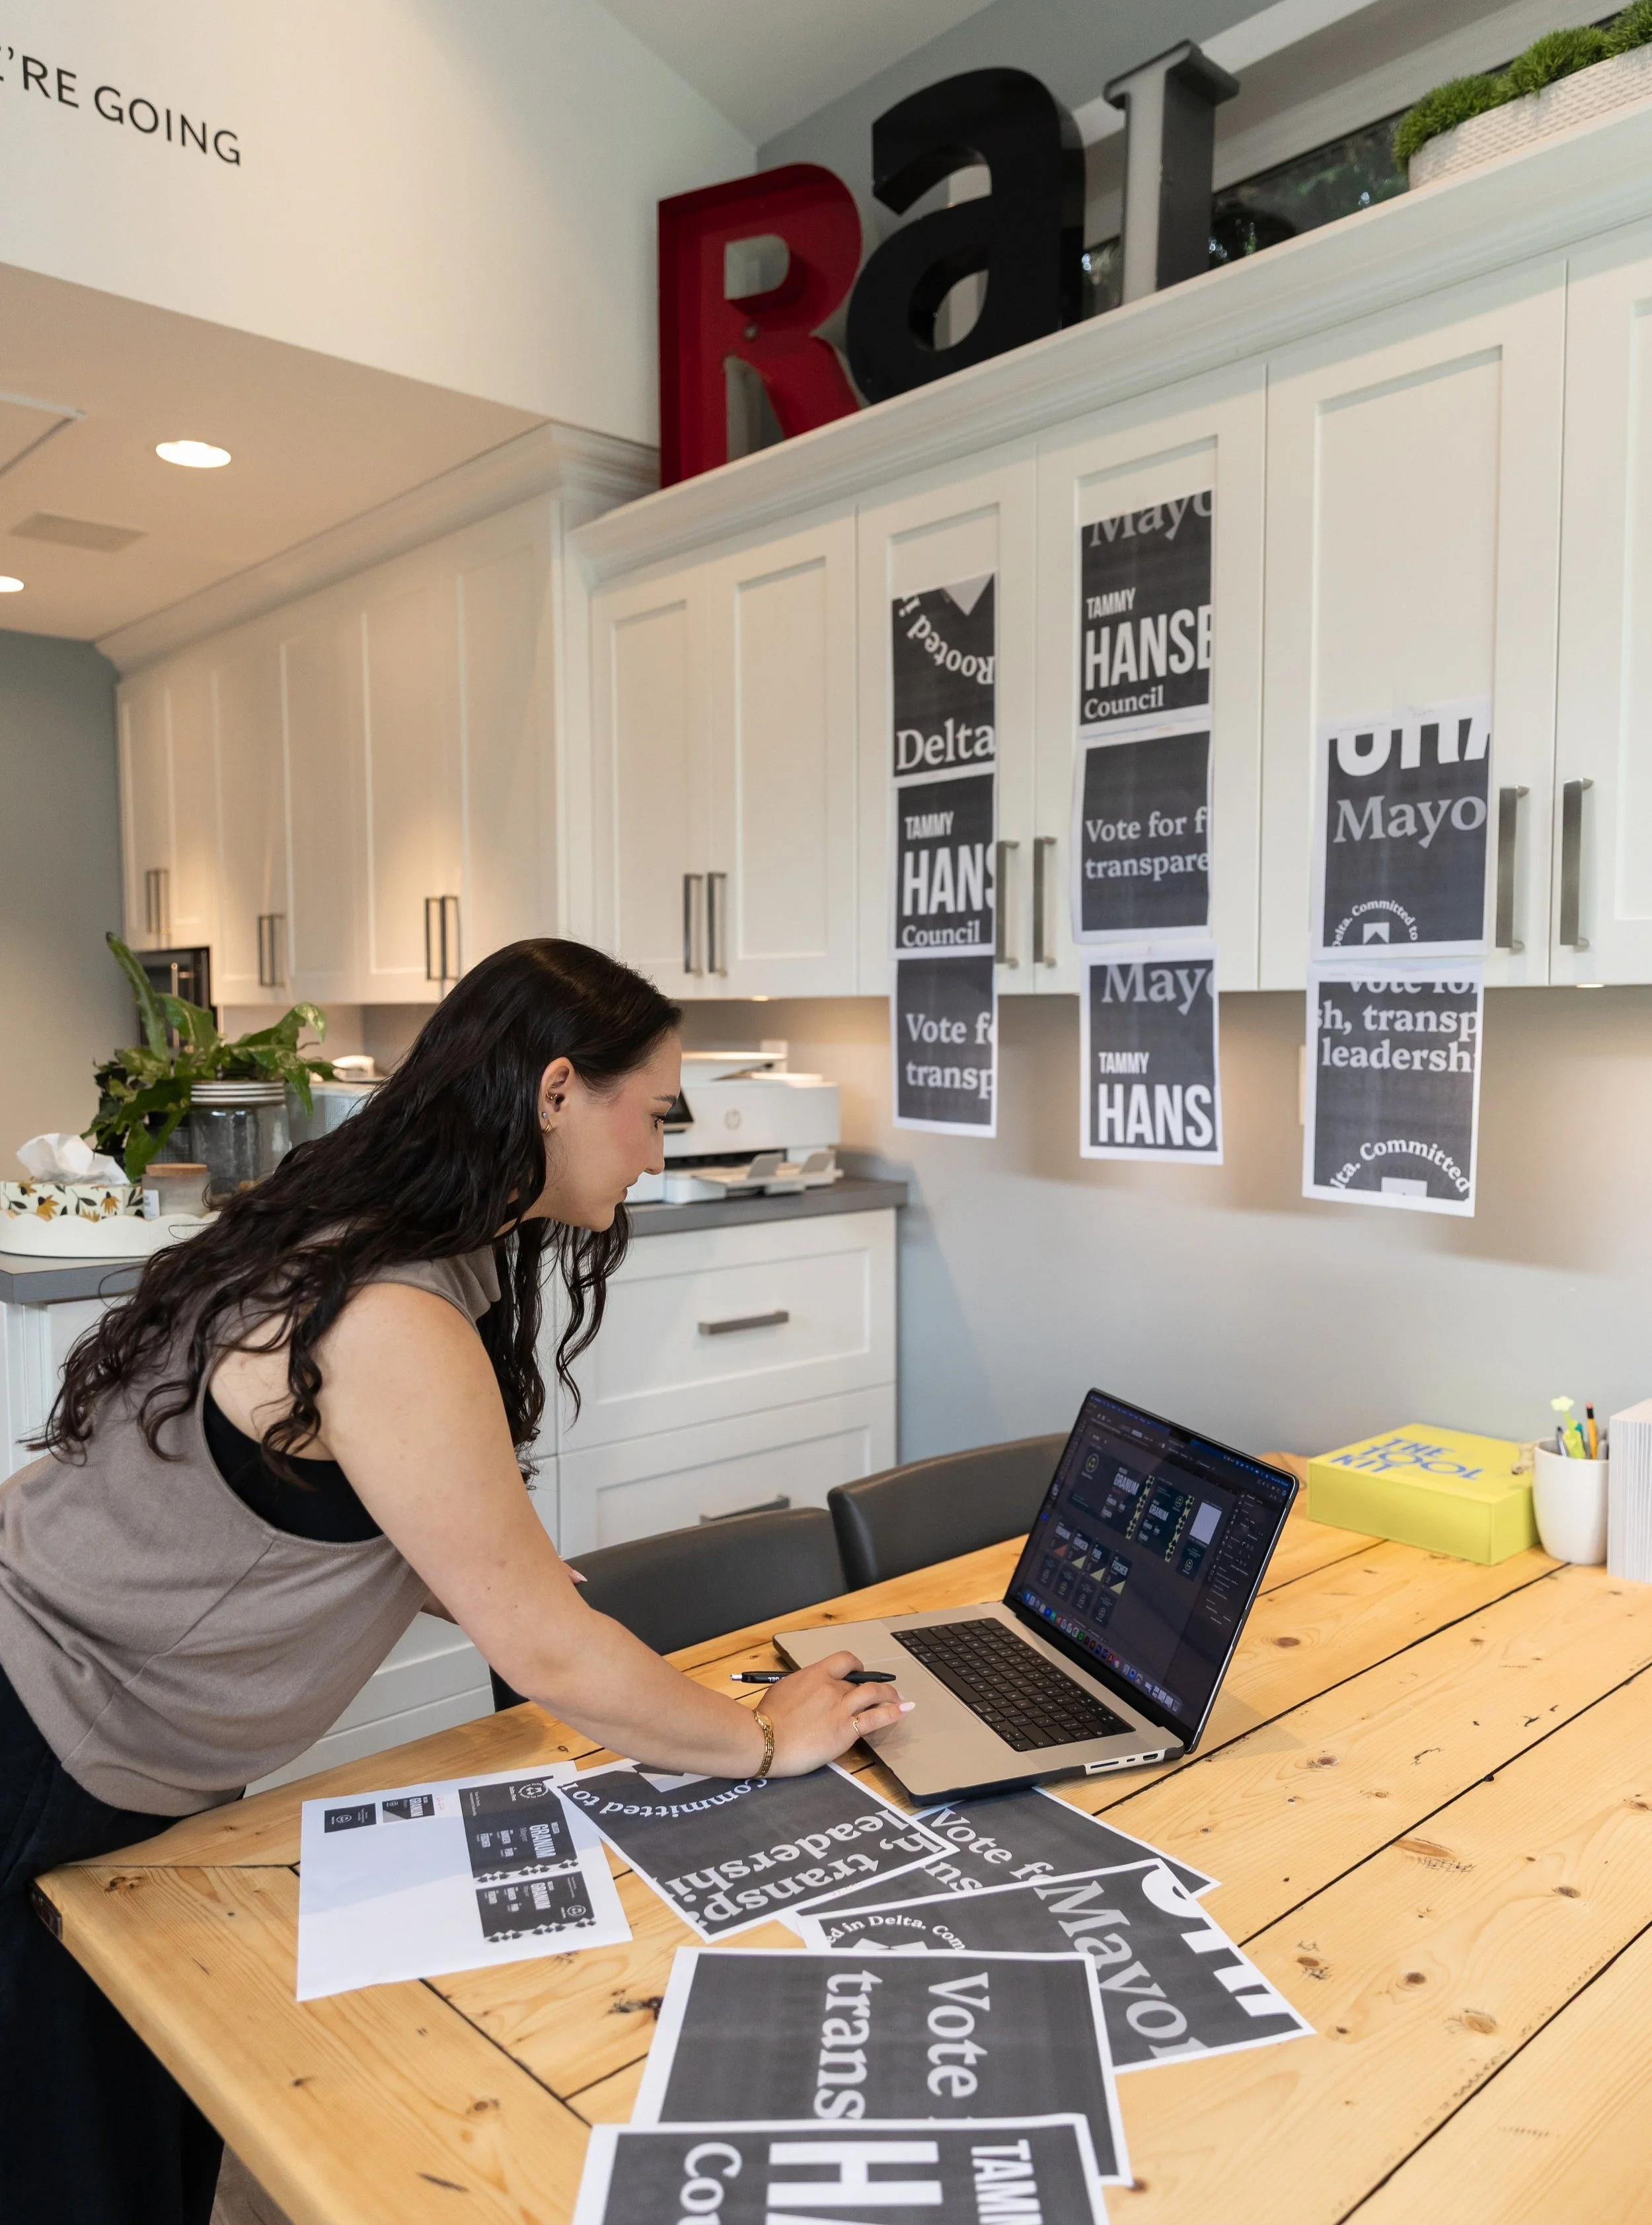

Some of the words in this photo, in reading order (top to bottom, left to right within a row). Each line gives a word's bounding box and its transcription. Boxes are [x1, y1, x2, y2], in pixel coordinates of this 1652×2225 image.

[0, 46, 79, 108] 'RE
[94, 85, 241, 165] GOING
[1086, 587, 1136, 620] TAMMY
[907, 614, 995, 685] Rooted
[1084, 685, 1164, 719] Council
[896, 718, 996, 771] Delta
[905, 811, 954, 840] TAMMY
[1085, 818, 1141, 843] Vote
[1148, 810, 1187, 838] for
[1333, 795, 1486, 849] Mayo
[901, 921, 981, 947] Council
[1351, 899, 1416, 926] Committed
[1408, 926, 1419, 941] to
[1101, 962, 1215, 1016] May
[906, 1012, 967, 1044] Vote
[1098, 1051, 1150, 1075] TAMMY
[1360, 1139, 1470, 1193] Committed
[1330, 1454, 1401, 1472] KIT
[1361, 1446, 1484, 1481] TOOL
[572, 1790, 601, 1807] to
[599, 1778, 767, 1818] Committed
[529, 1823, 557, 1859] GRANUM
[930, 1807, 1013, 1864] Vote
[841, 1920, 866, 1933] in
[868, 1915, 926, 1930] Delta.
[813, 1970, 883, 2120] trans
[926, 1972, 991, 2099] Vote
